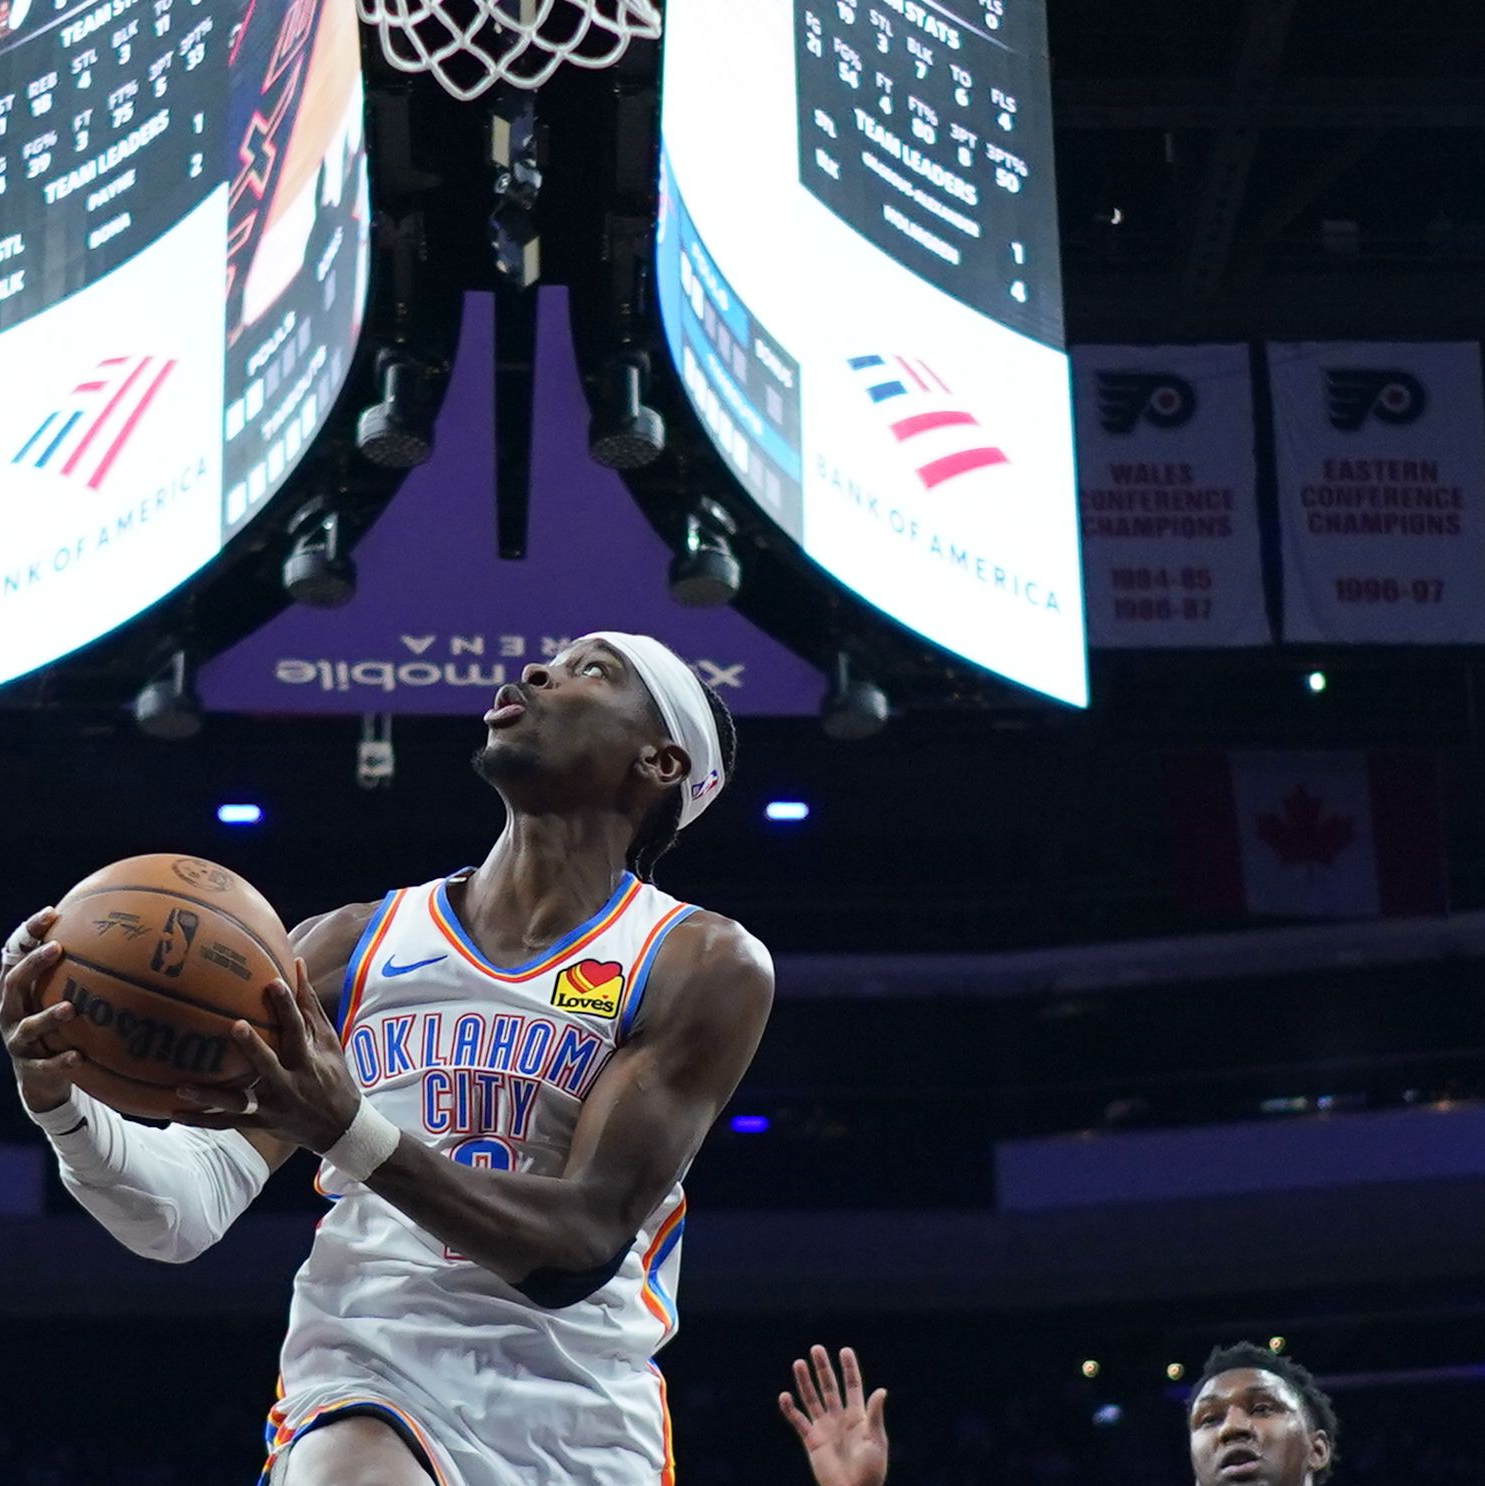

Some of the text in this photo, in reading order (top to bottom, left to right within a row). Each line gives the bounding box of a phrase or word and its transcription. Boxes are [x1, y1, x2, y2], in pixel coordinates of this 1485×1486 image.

[60, 3, 112, 48] TEAM
[905, 1, 961, 50] STATS
[985, 12, 998, 30] 0
[118, 43, 131, 65] 3
[877, 33, 889, 53] 3
[72, 48, 98, 74] STL
[915, 60, 928, 80] 7
[154, 76, 167, 97] 5
[876, 71, 893, 94] FT
[949, 64, 972, 88] TO
[955, 88, 969, 107] 6
[991, 88, 1017, 113] FLS
[73, 109, 93, 132] FT
[193, 112, 204, 134] 1
[997, 112, 1012, 131] 4
[75, 130, 89, 152] 3
[950, 123, 978, 149] 3PT
[44, 109, 170, 204] TEAM LEADERS
[853, 108, 901, 159] TEAM
[903, 144, 979, 206] LEADERS
[1011, 242, 1023, 265] 1
[1109, 462, 1194, 485] WALES
[1324, 459, 1439, 485] EASTERN
[1300, 487, 1465, 512] CONFERENCE
[53, 538, 86, 574] OF
[97, 456, 208, 548] AMERICA
[1306, 512, 1461, 537] CHAMPIONS
[817, 453, 1061, 615] BANK OF AMERICA
[275, 658, 507, 693] mobile
[350, 1012, 614, 1102] OKLAHOM
[421, 1067, 541, 1142] CITY
